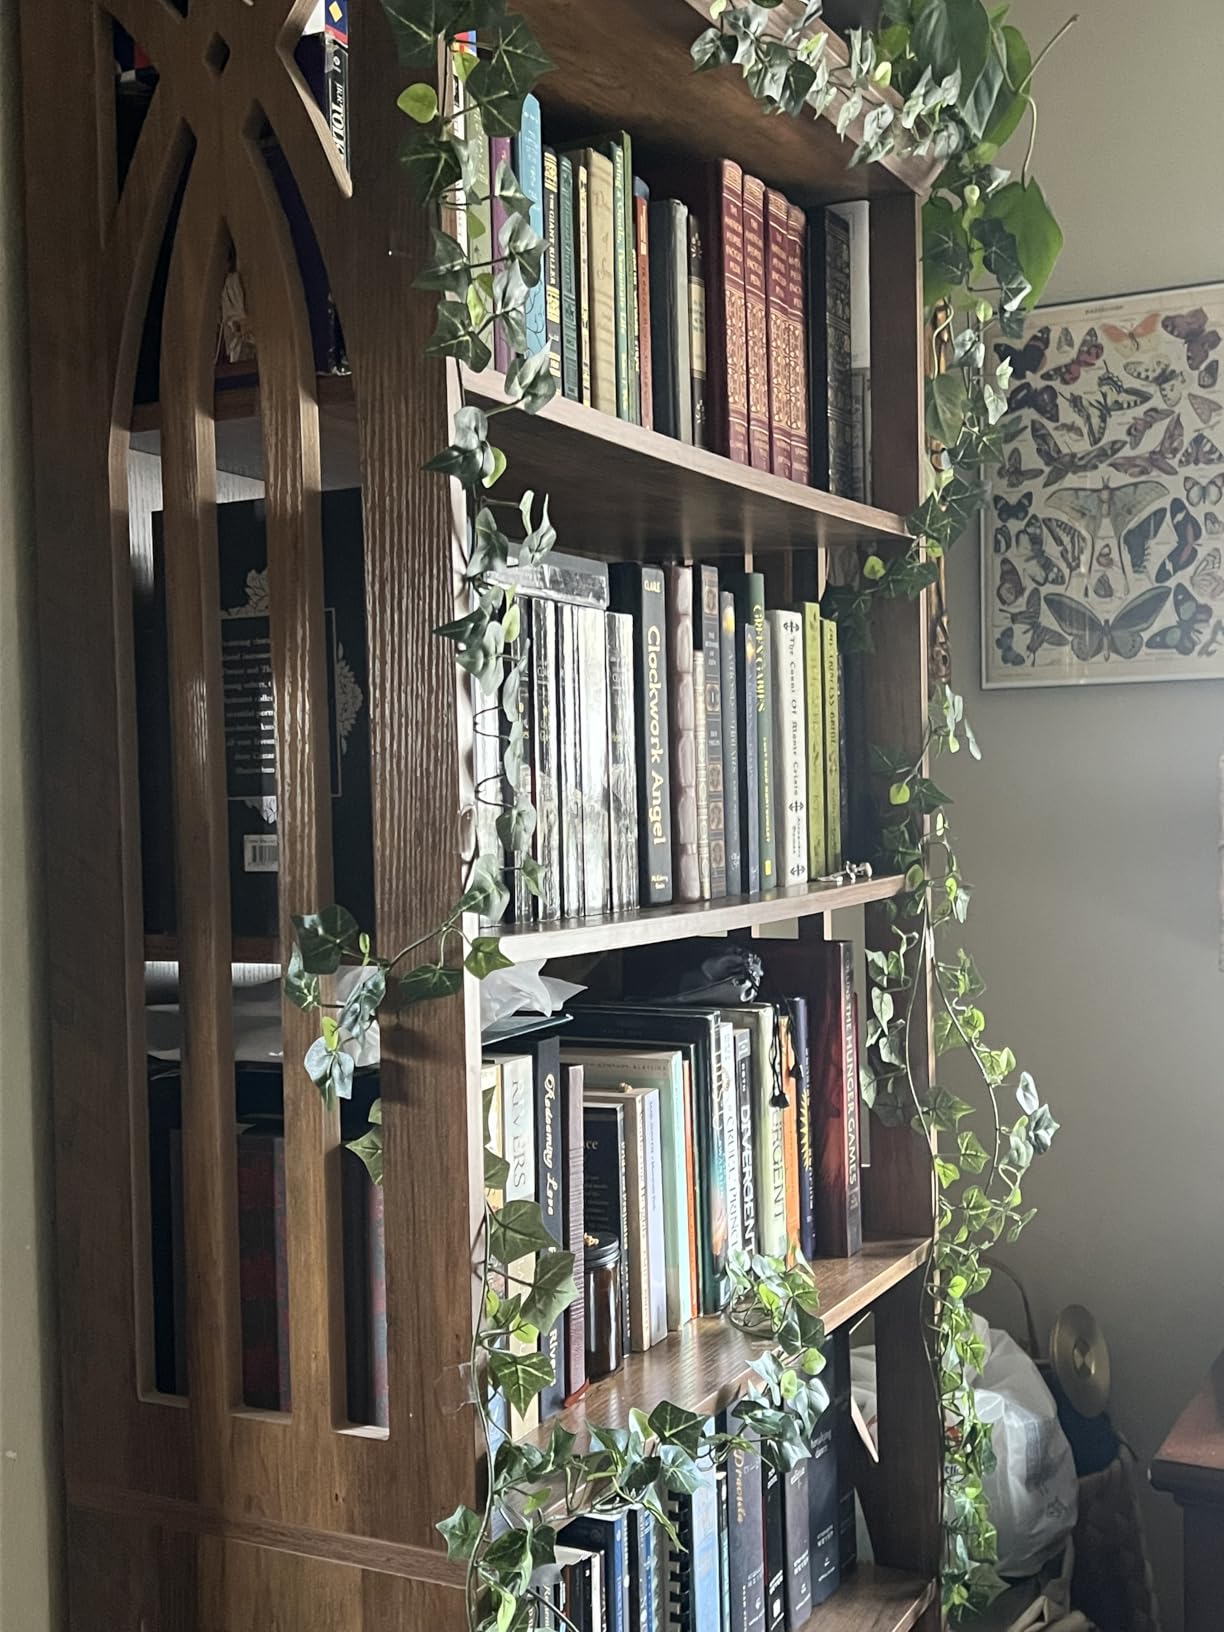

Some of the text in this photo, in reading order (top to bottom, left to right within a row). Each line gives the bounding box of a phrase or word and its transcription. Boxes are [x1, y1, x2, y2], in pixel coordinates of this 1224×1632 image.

[788, 637, 796, 655] The
[789, 661, 797, 693] Count
[646, 624, 667, 846] Clockwork Angel
[790, 721, 799, 755] Monte
[846, 1034, 854, 1113] HUNGER
[512, 1079, 526, 1188] RIVERS
[543, 1073, 559, 1216] Redeeming Love
[848, 1117, 857, 1184] GAMES
[740, 1104, 756, 1255] DIVERGENT
[733, 1450, 746, 1525] Dracula
